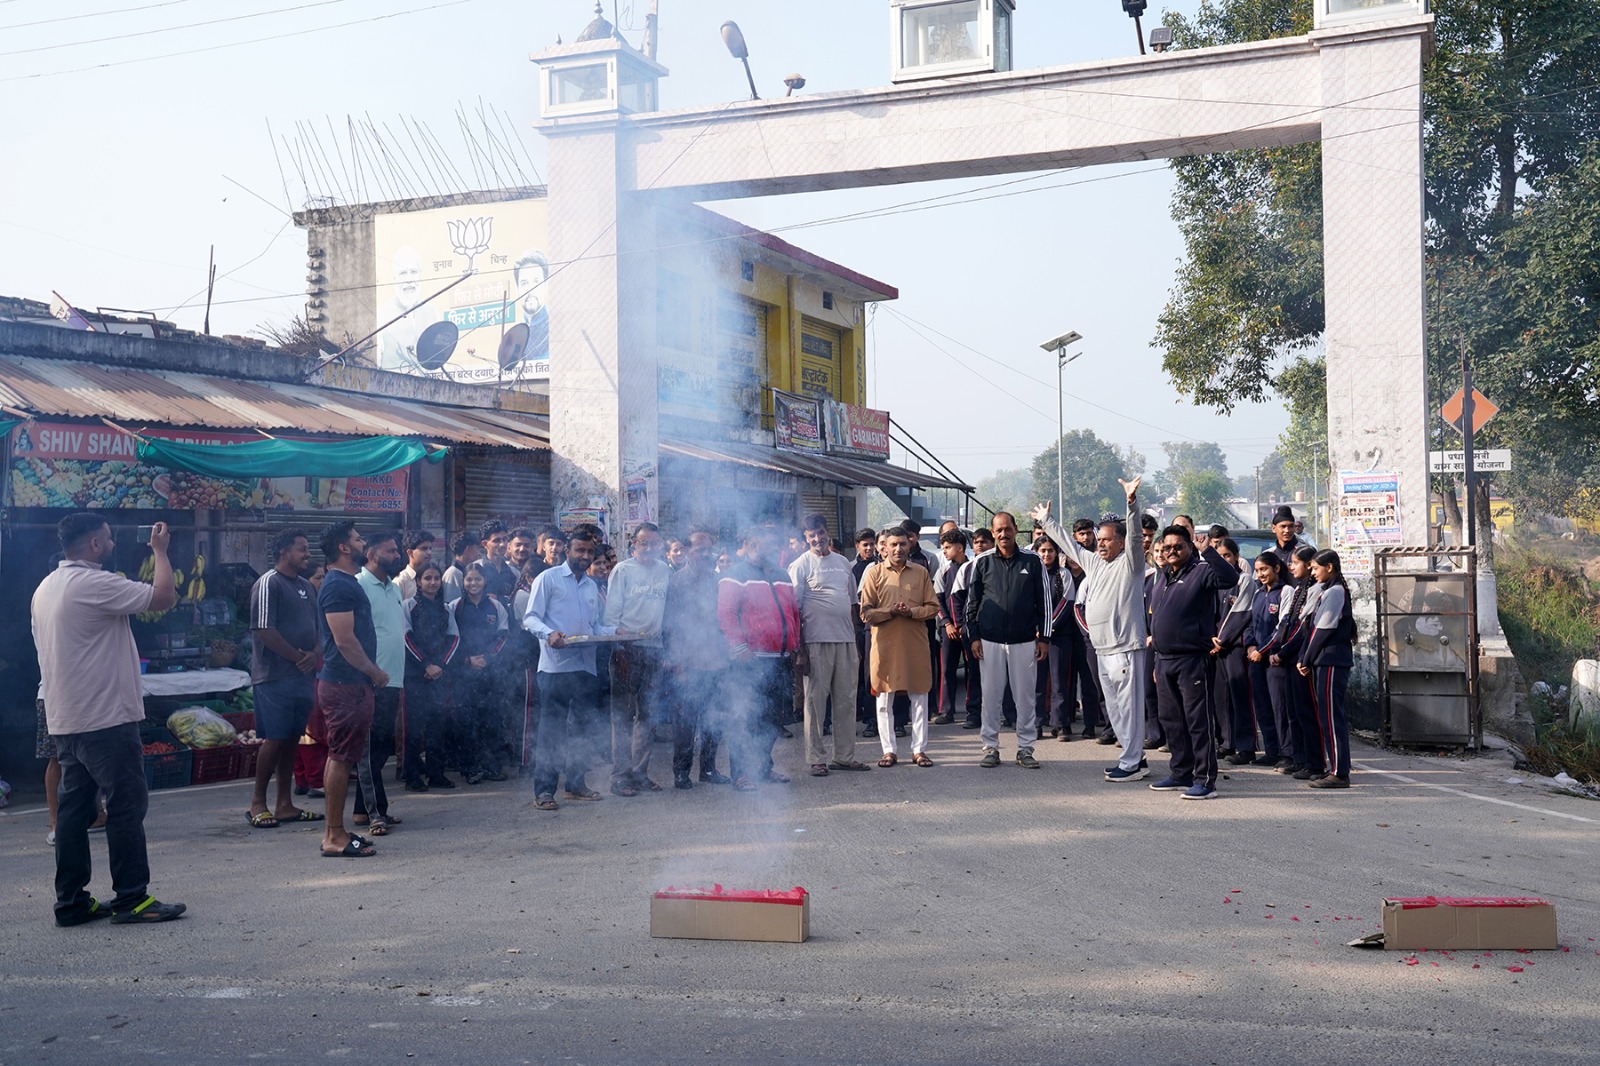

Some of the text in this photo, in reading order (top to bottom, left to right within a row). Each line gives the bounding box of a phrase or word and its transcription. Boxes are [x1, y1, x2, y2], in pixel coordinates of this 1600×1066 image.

[433, 254, 508, 272] चुनाव चिन्ह
[448, 311, 467, 326] फिर
[468, 306, 477, 323] से
[535, 362, 549, 373] जित
[39, 430, 84, 453] SHIV
[852, 428, 888, 448] GARMENTS
[1477, 460, 1505, 470] योजना
[351, 486, 385, 497] Contact
